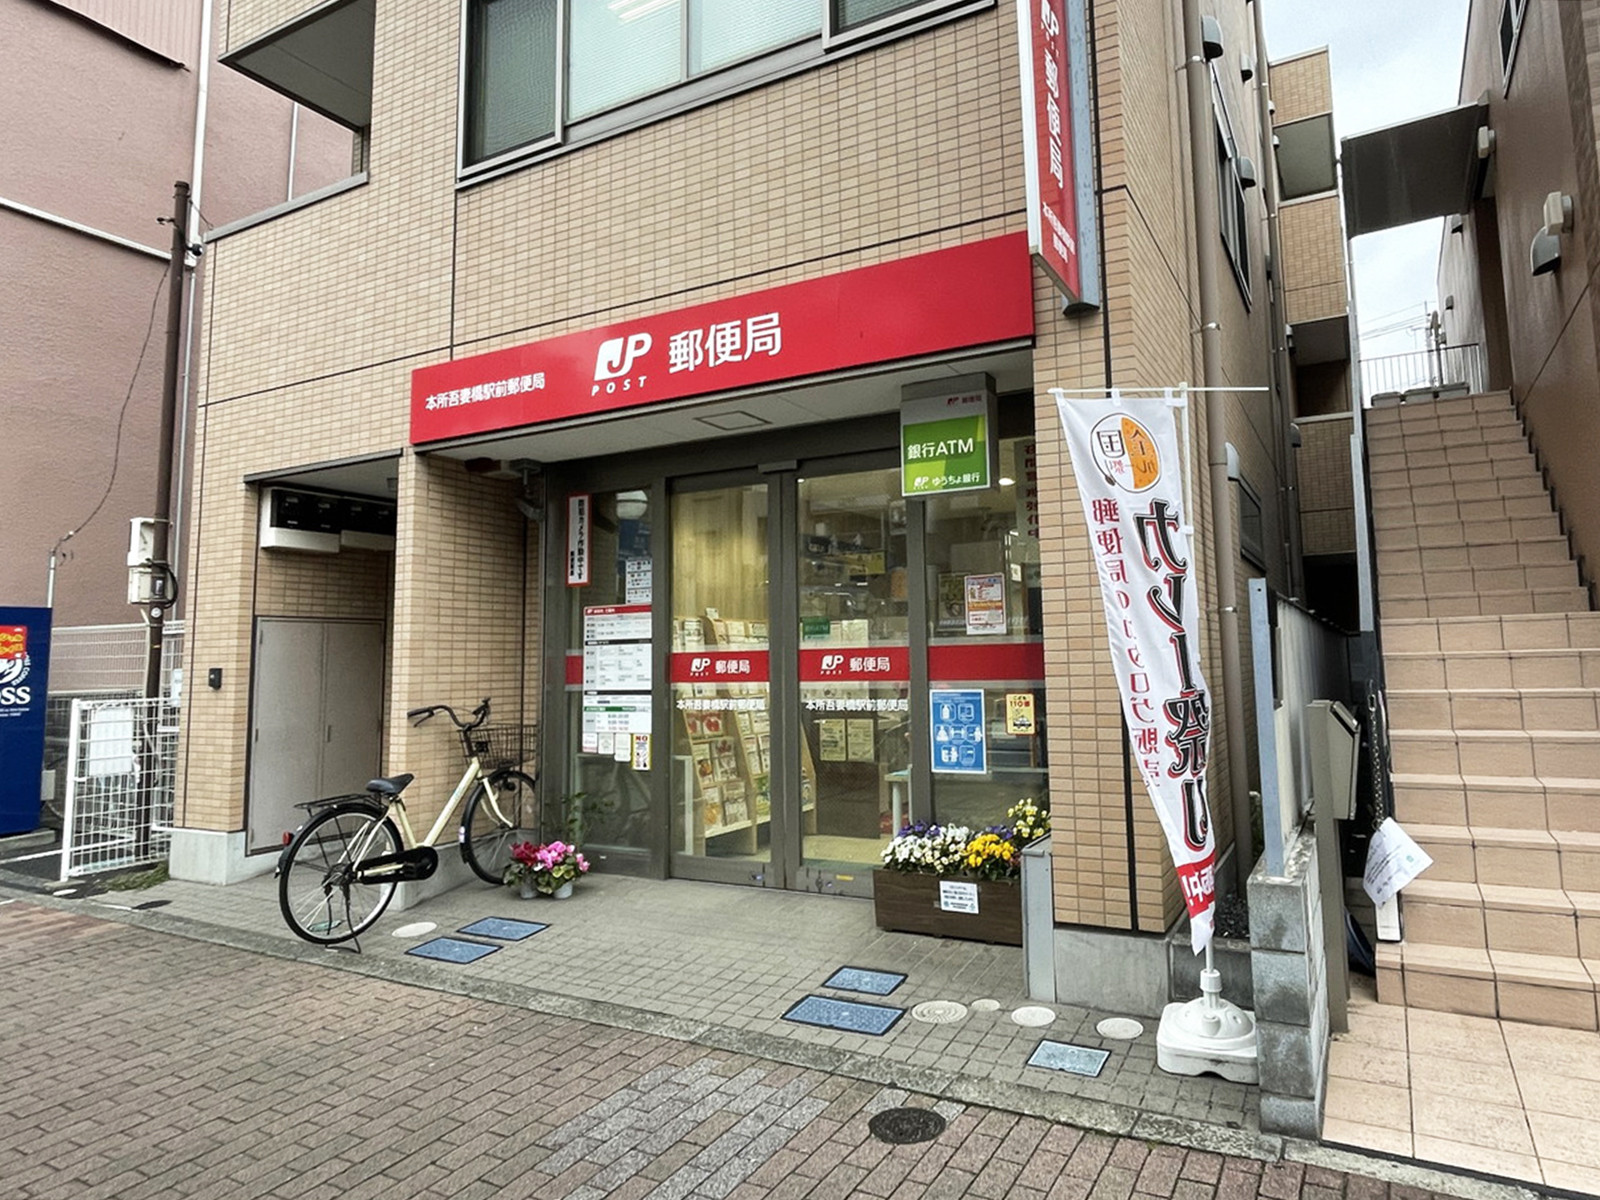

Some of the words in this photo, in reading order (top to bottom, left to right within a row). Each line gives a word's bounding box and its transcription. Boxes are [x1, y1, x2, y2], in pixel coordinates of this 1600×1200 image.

[1044, 48, 1064, 189] 郵便局
[668, 311, 782, 374] 郵便局
[594, 332, 652, 382] JP
[425, 372, 546, 410] 本所吾妻橋駅前郵便局
[591, 376, 648, 396] POST
[907, 438, 974, 460] 銀行ATM
[931, 472, 981, 486] ゆうちょ銀行
[715, 659, 750, 674] 郵便局
[849, 657, 890, 672] 郵便局
[0, 686, 31, 705] SS
